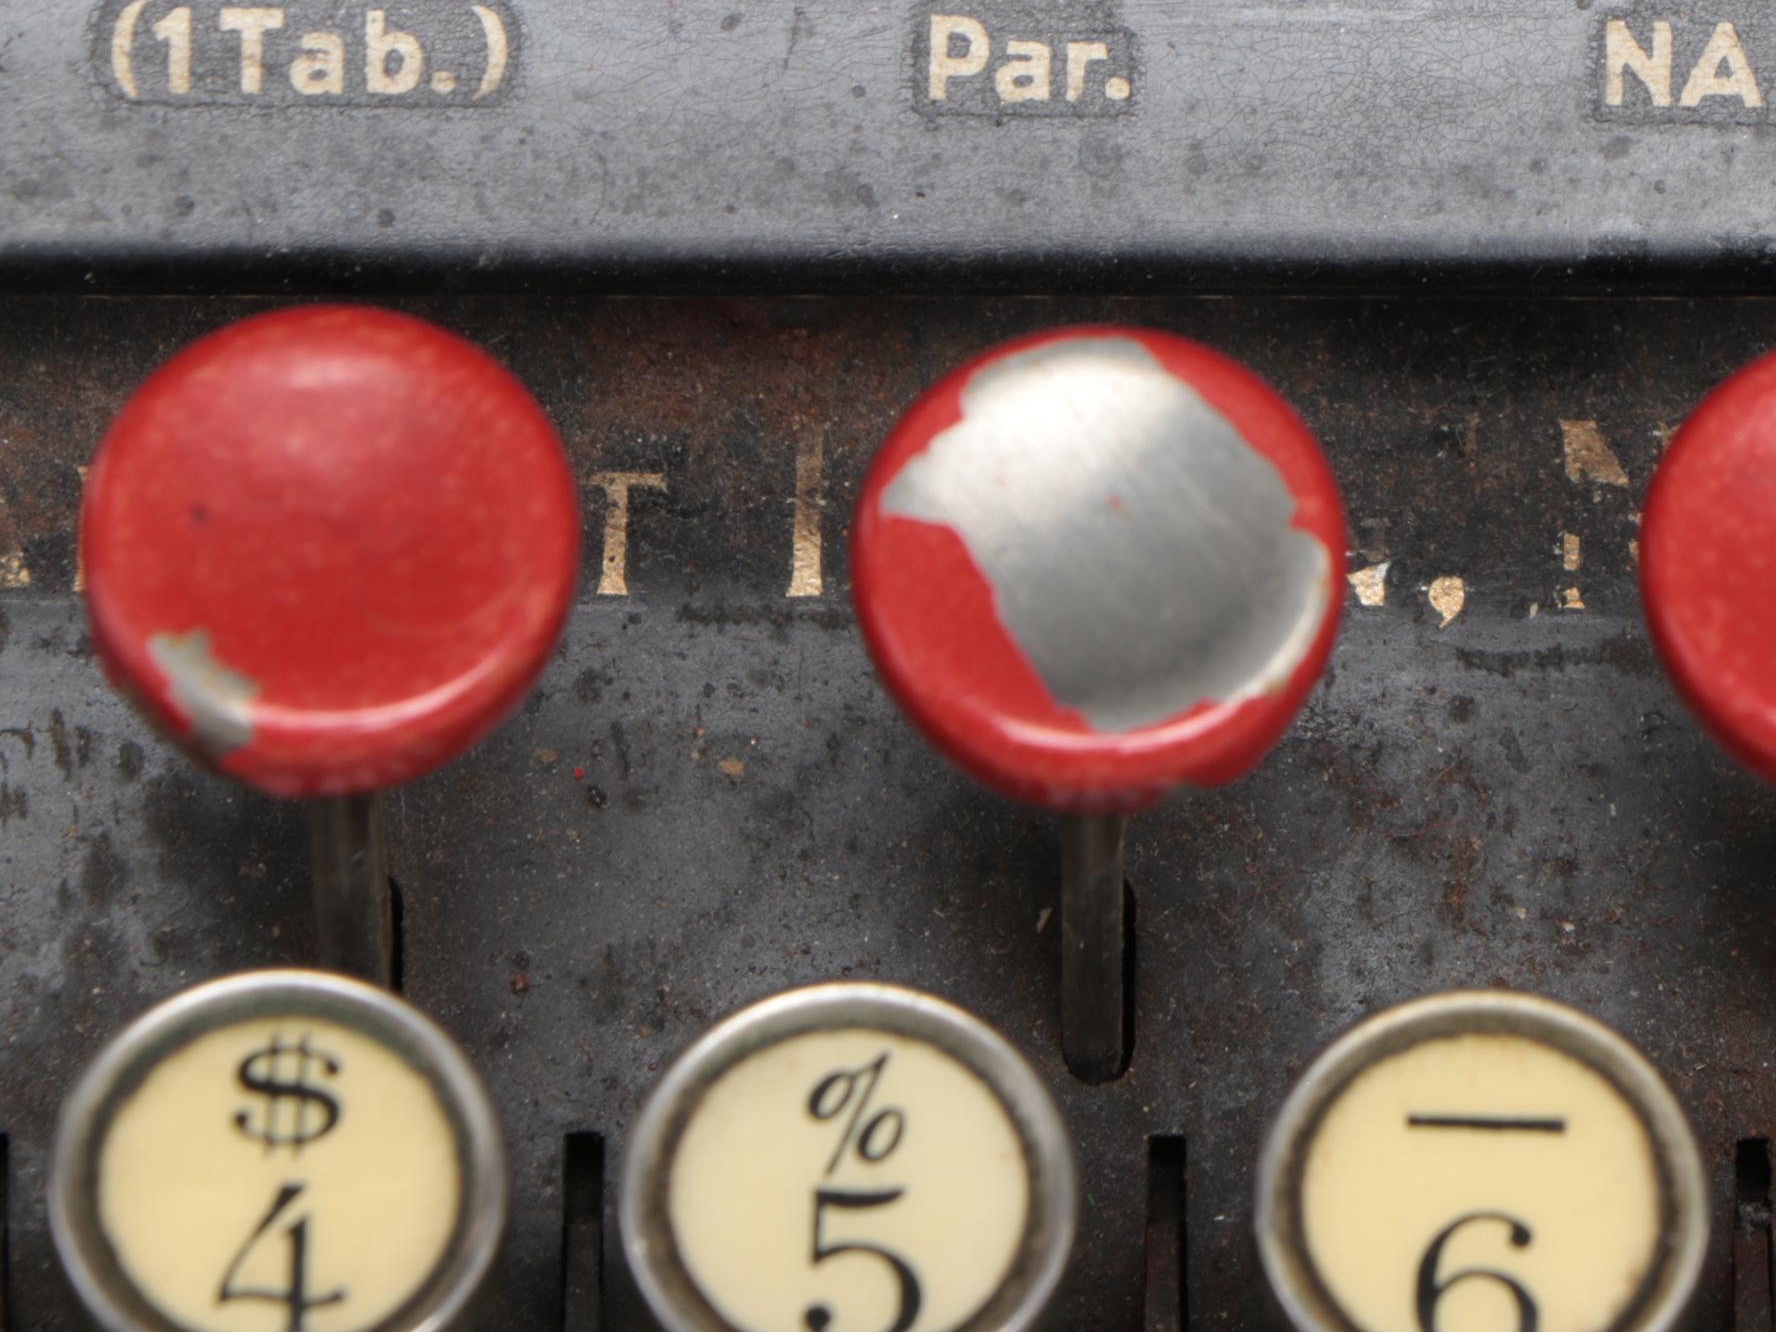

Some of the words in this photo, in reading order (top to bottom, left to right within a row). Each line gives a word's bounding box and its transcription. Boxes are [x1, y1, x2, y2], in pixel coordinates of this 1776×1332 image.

[929, 15, 1133, 102] Par.
[232, 1031, 341, 1159] $
[806, 1049, 907, 1177] %
[214, 1182, 347, 1332] 4
[805, 1184, 922, 1332] 5
